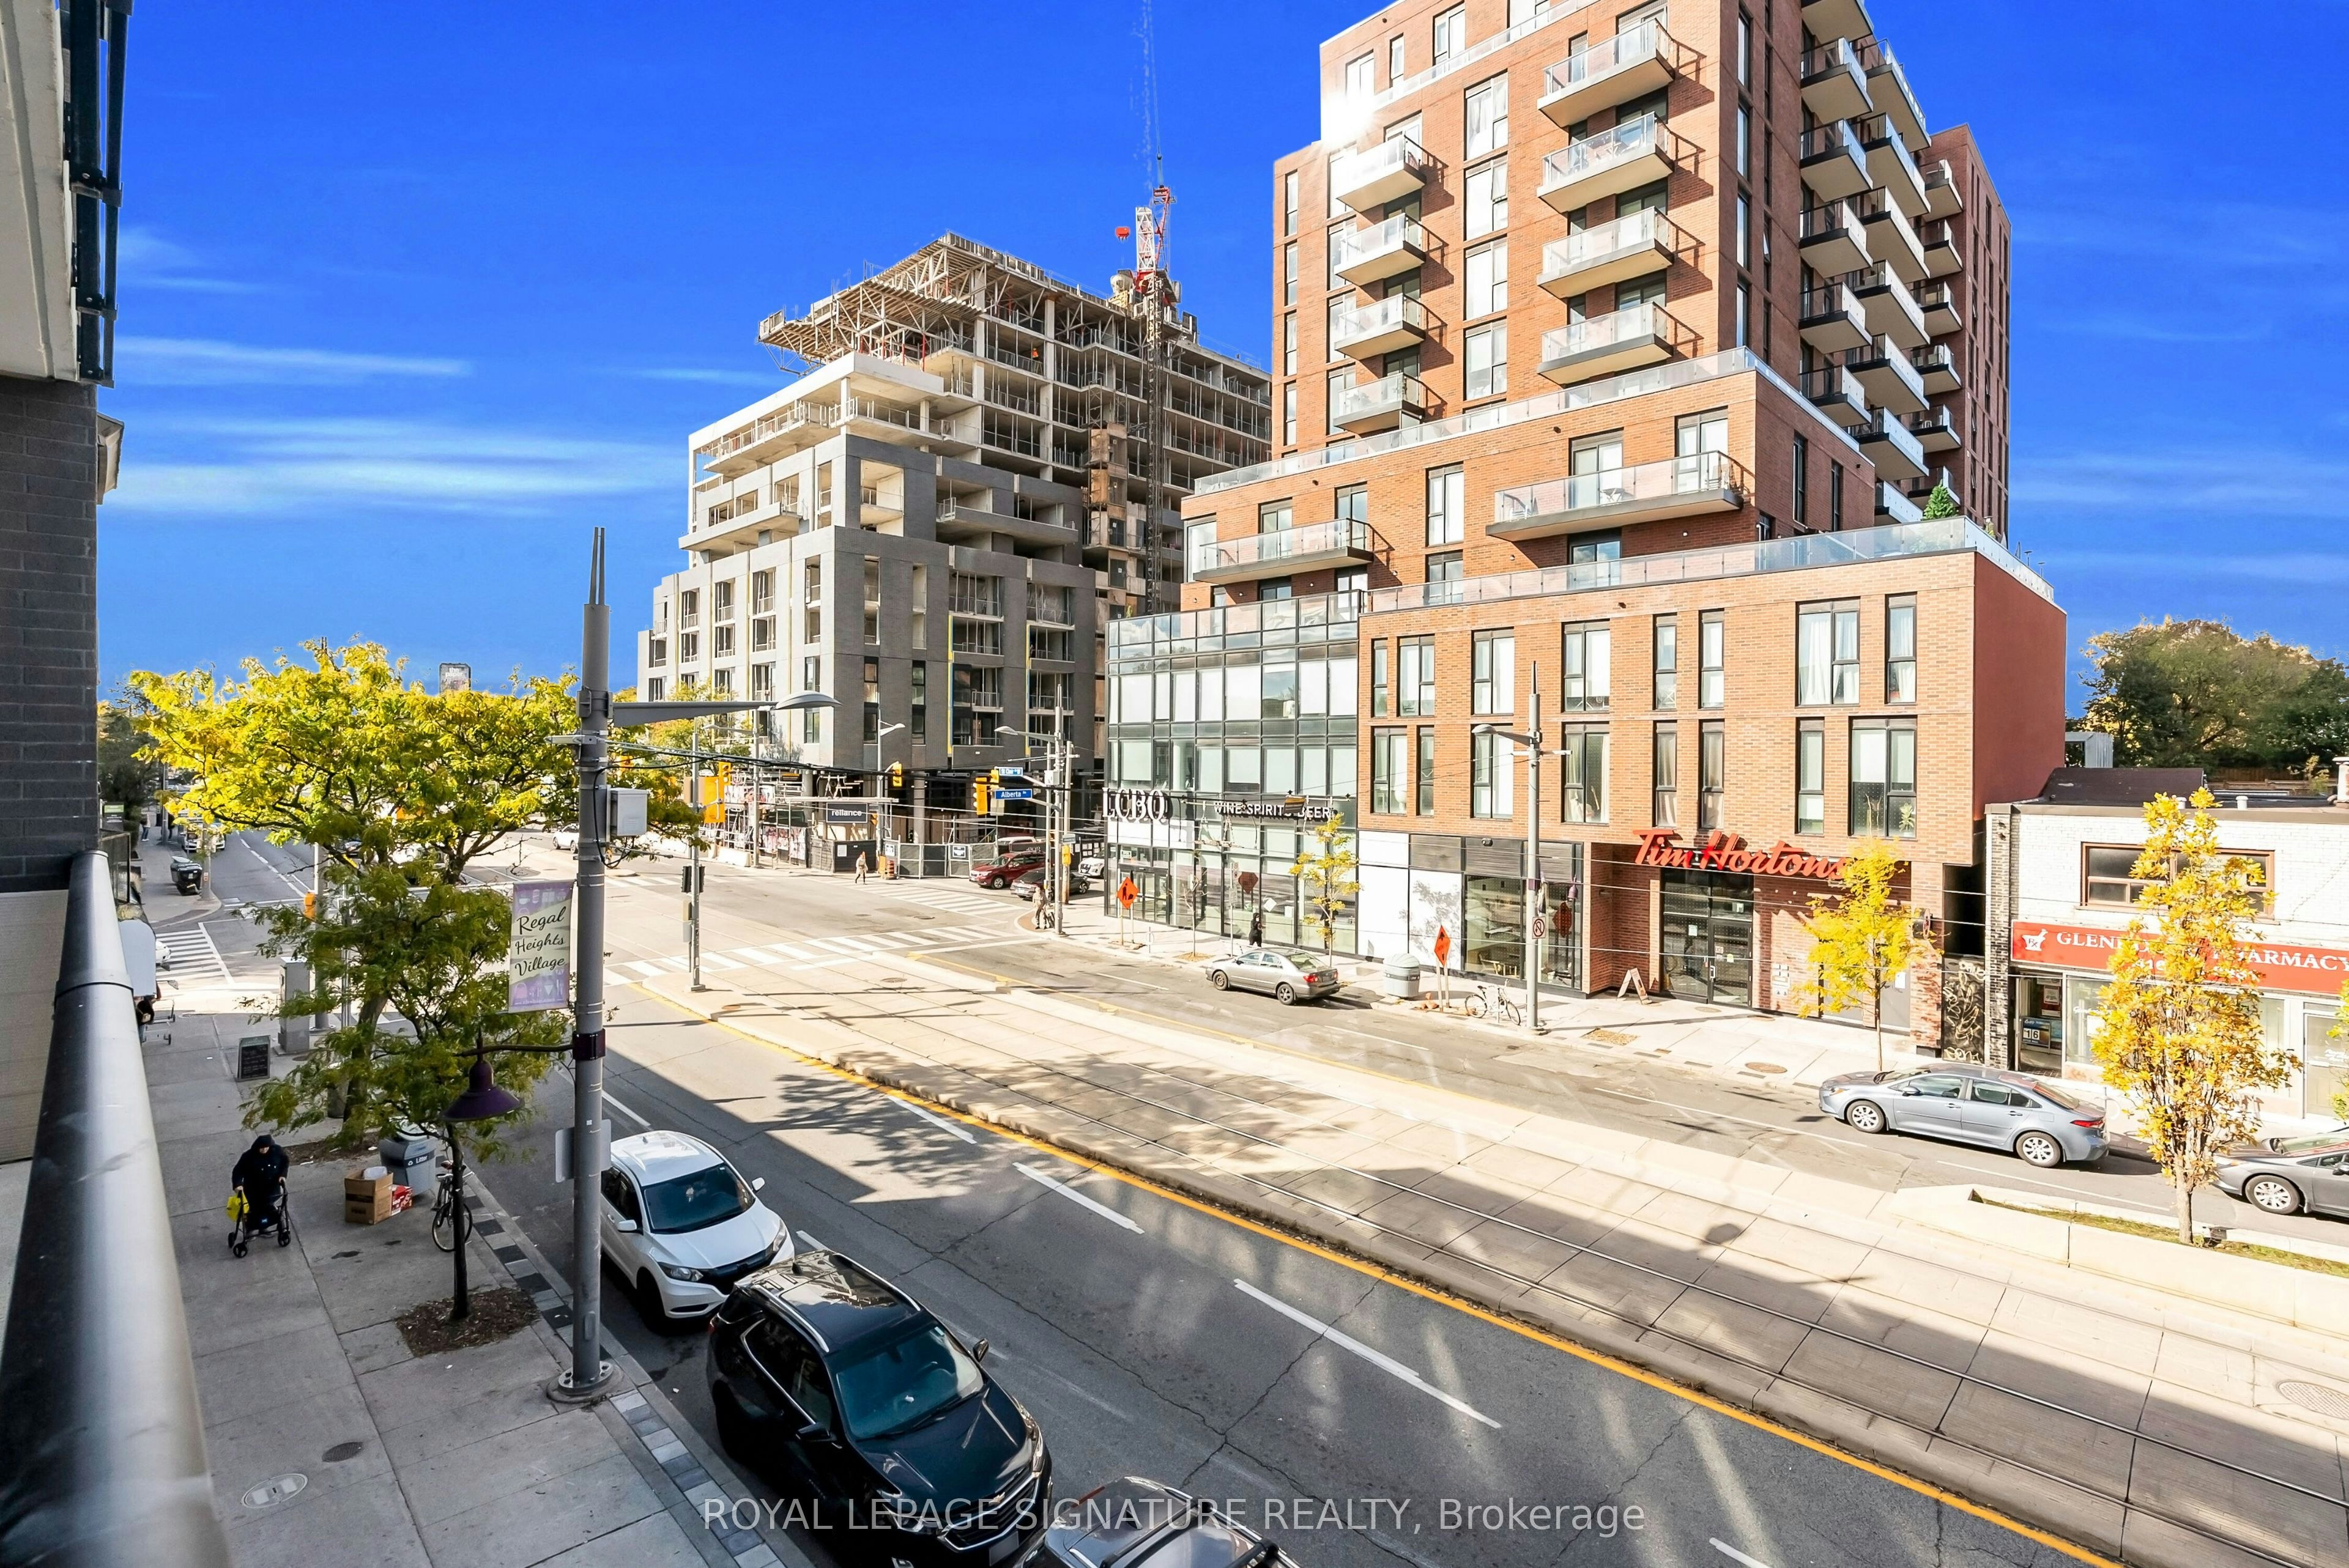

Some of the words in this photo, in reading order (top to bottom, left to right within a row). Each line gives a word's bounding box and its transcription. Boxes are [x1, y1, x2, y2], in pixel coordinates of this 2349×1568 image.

[1102, 787, 1165, 820] LCBO
[1213, 802, 1242, 815] WINE
[1633, 829, 1693, 868] Tim
[516, 906, 567, 935] Regal
[514, 933, 565, 955] Heights
[514, 956, 565, 976] Village
[416, 1155, 428, 1164] Litter
